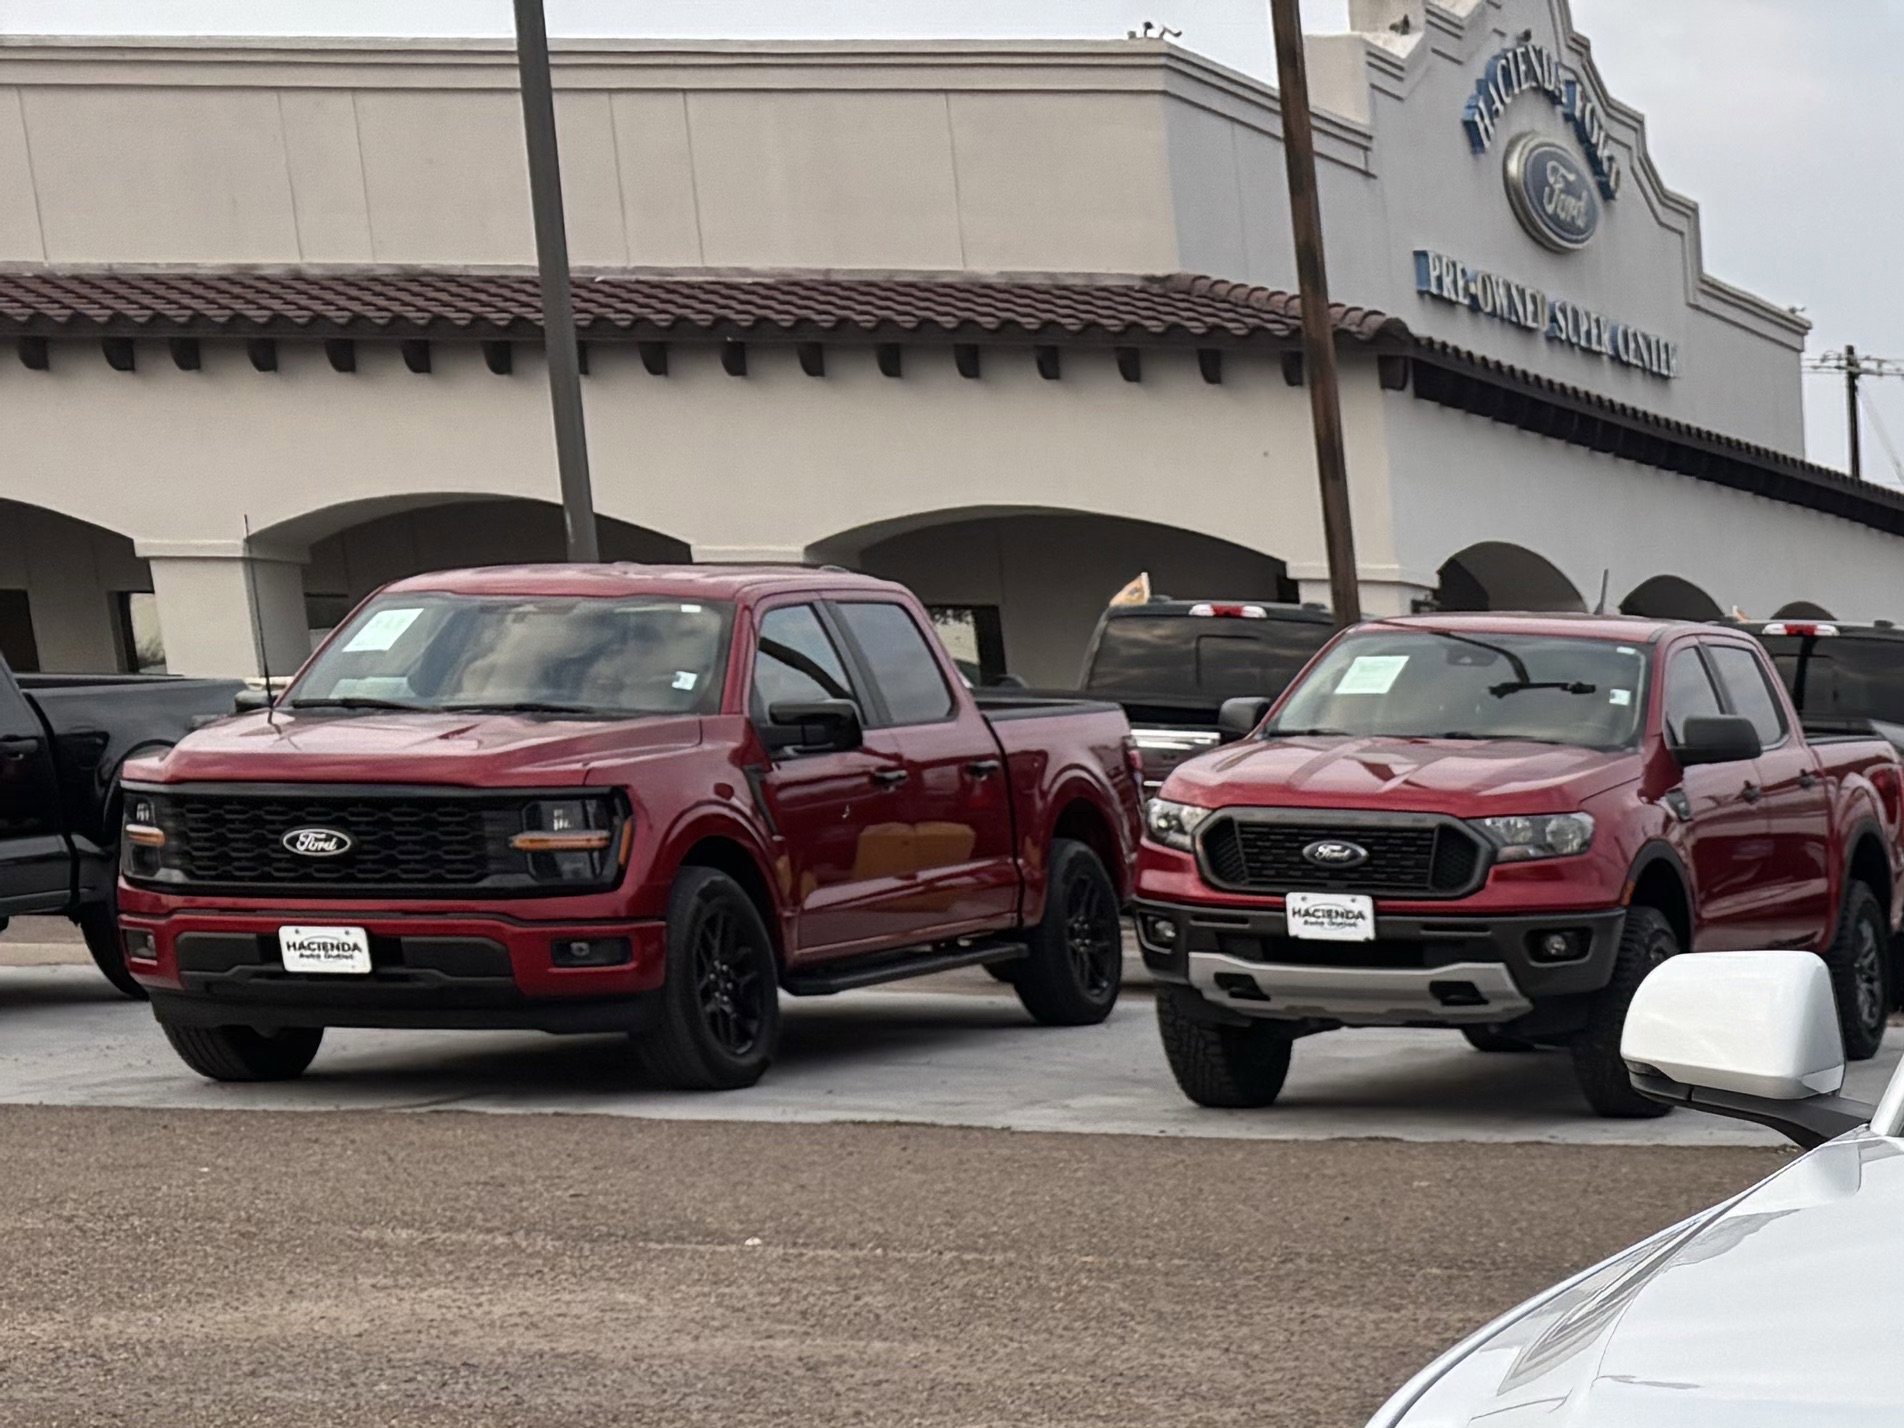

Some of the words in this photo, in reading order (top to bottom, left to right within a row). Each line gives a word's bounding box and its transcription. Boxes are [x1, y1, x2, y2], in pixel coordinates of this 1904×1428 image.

[1542, 160, 1589, 230] Ford
[1416, 250, 1548, 331] PRE-OWNED
[286, 941, 362, 953] HACIENDA
